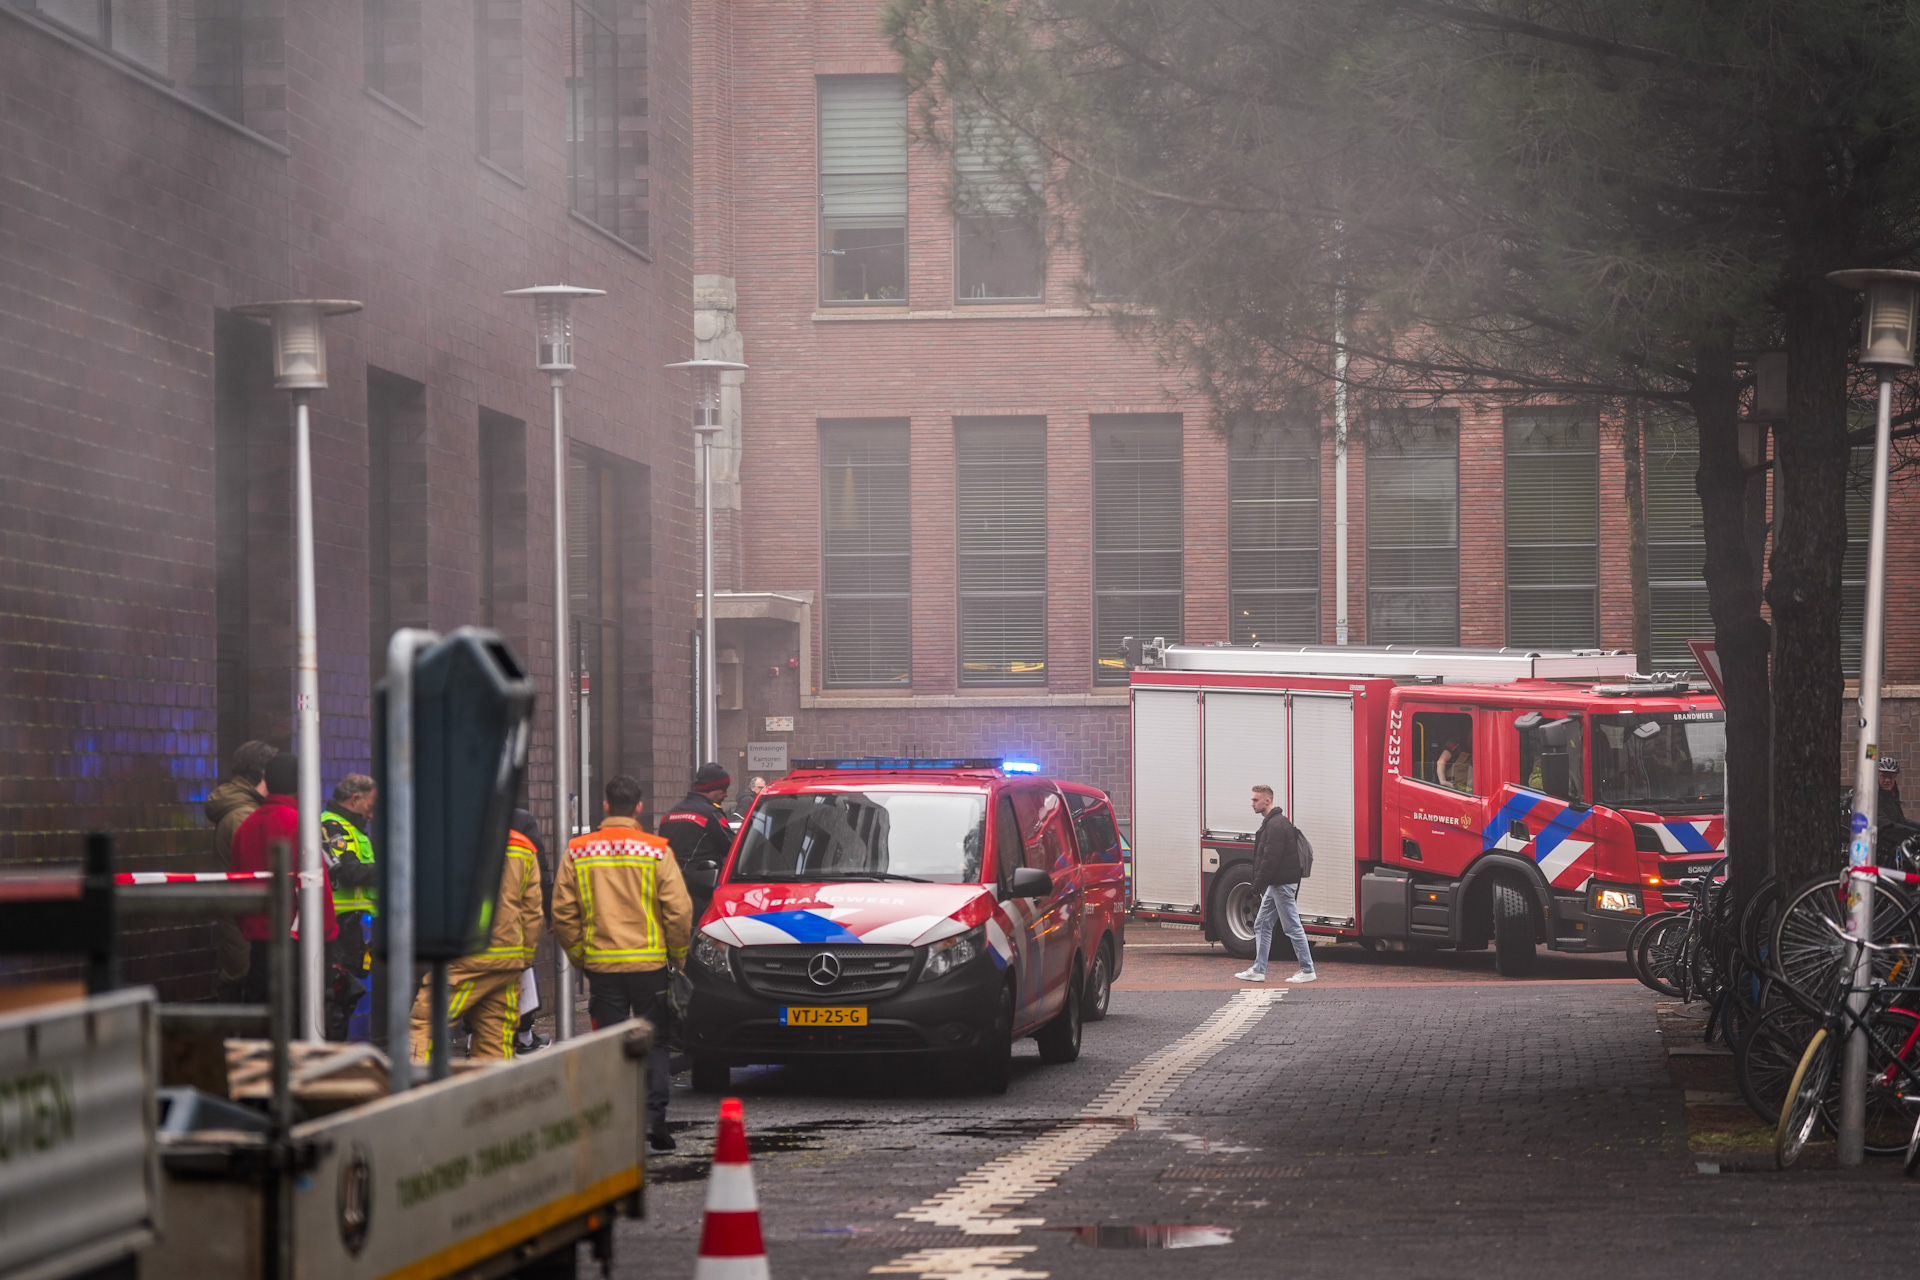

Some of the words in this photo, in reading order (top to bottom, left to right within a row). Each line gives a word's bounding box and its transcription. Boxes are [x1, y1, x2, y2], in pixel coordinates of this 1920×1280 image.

[1674, 712, 1713, 720] BRANDWEER
[1388, 710, 1402, 774] 22-2331
[1414, 812, 1459, 825] BRANDWEER
[770, 897, 904, 906] BRANDWEER
[792, 1009, 860, 1023] VTJ-25-G
